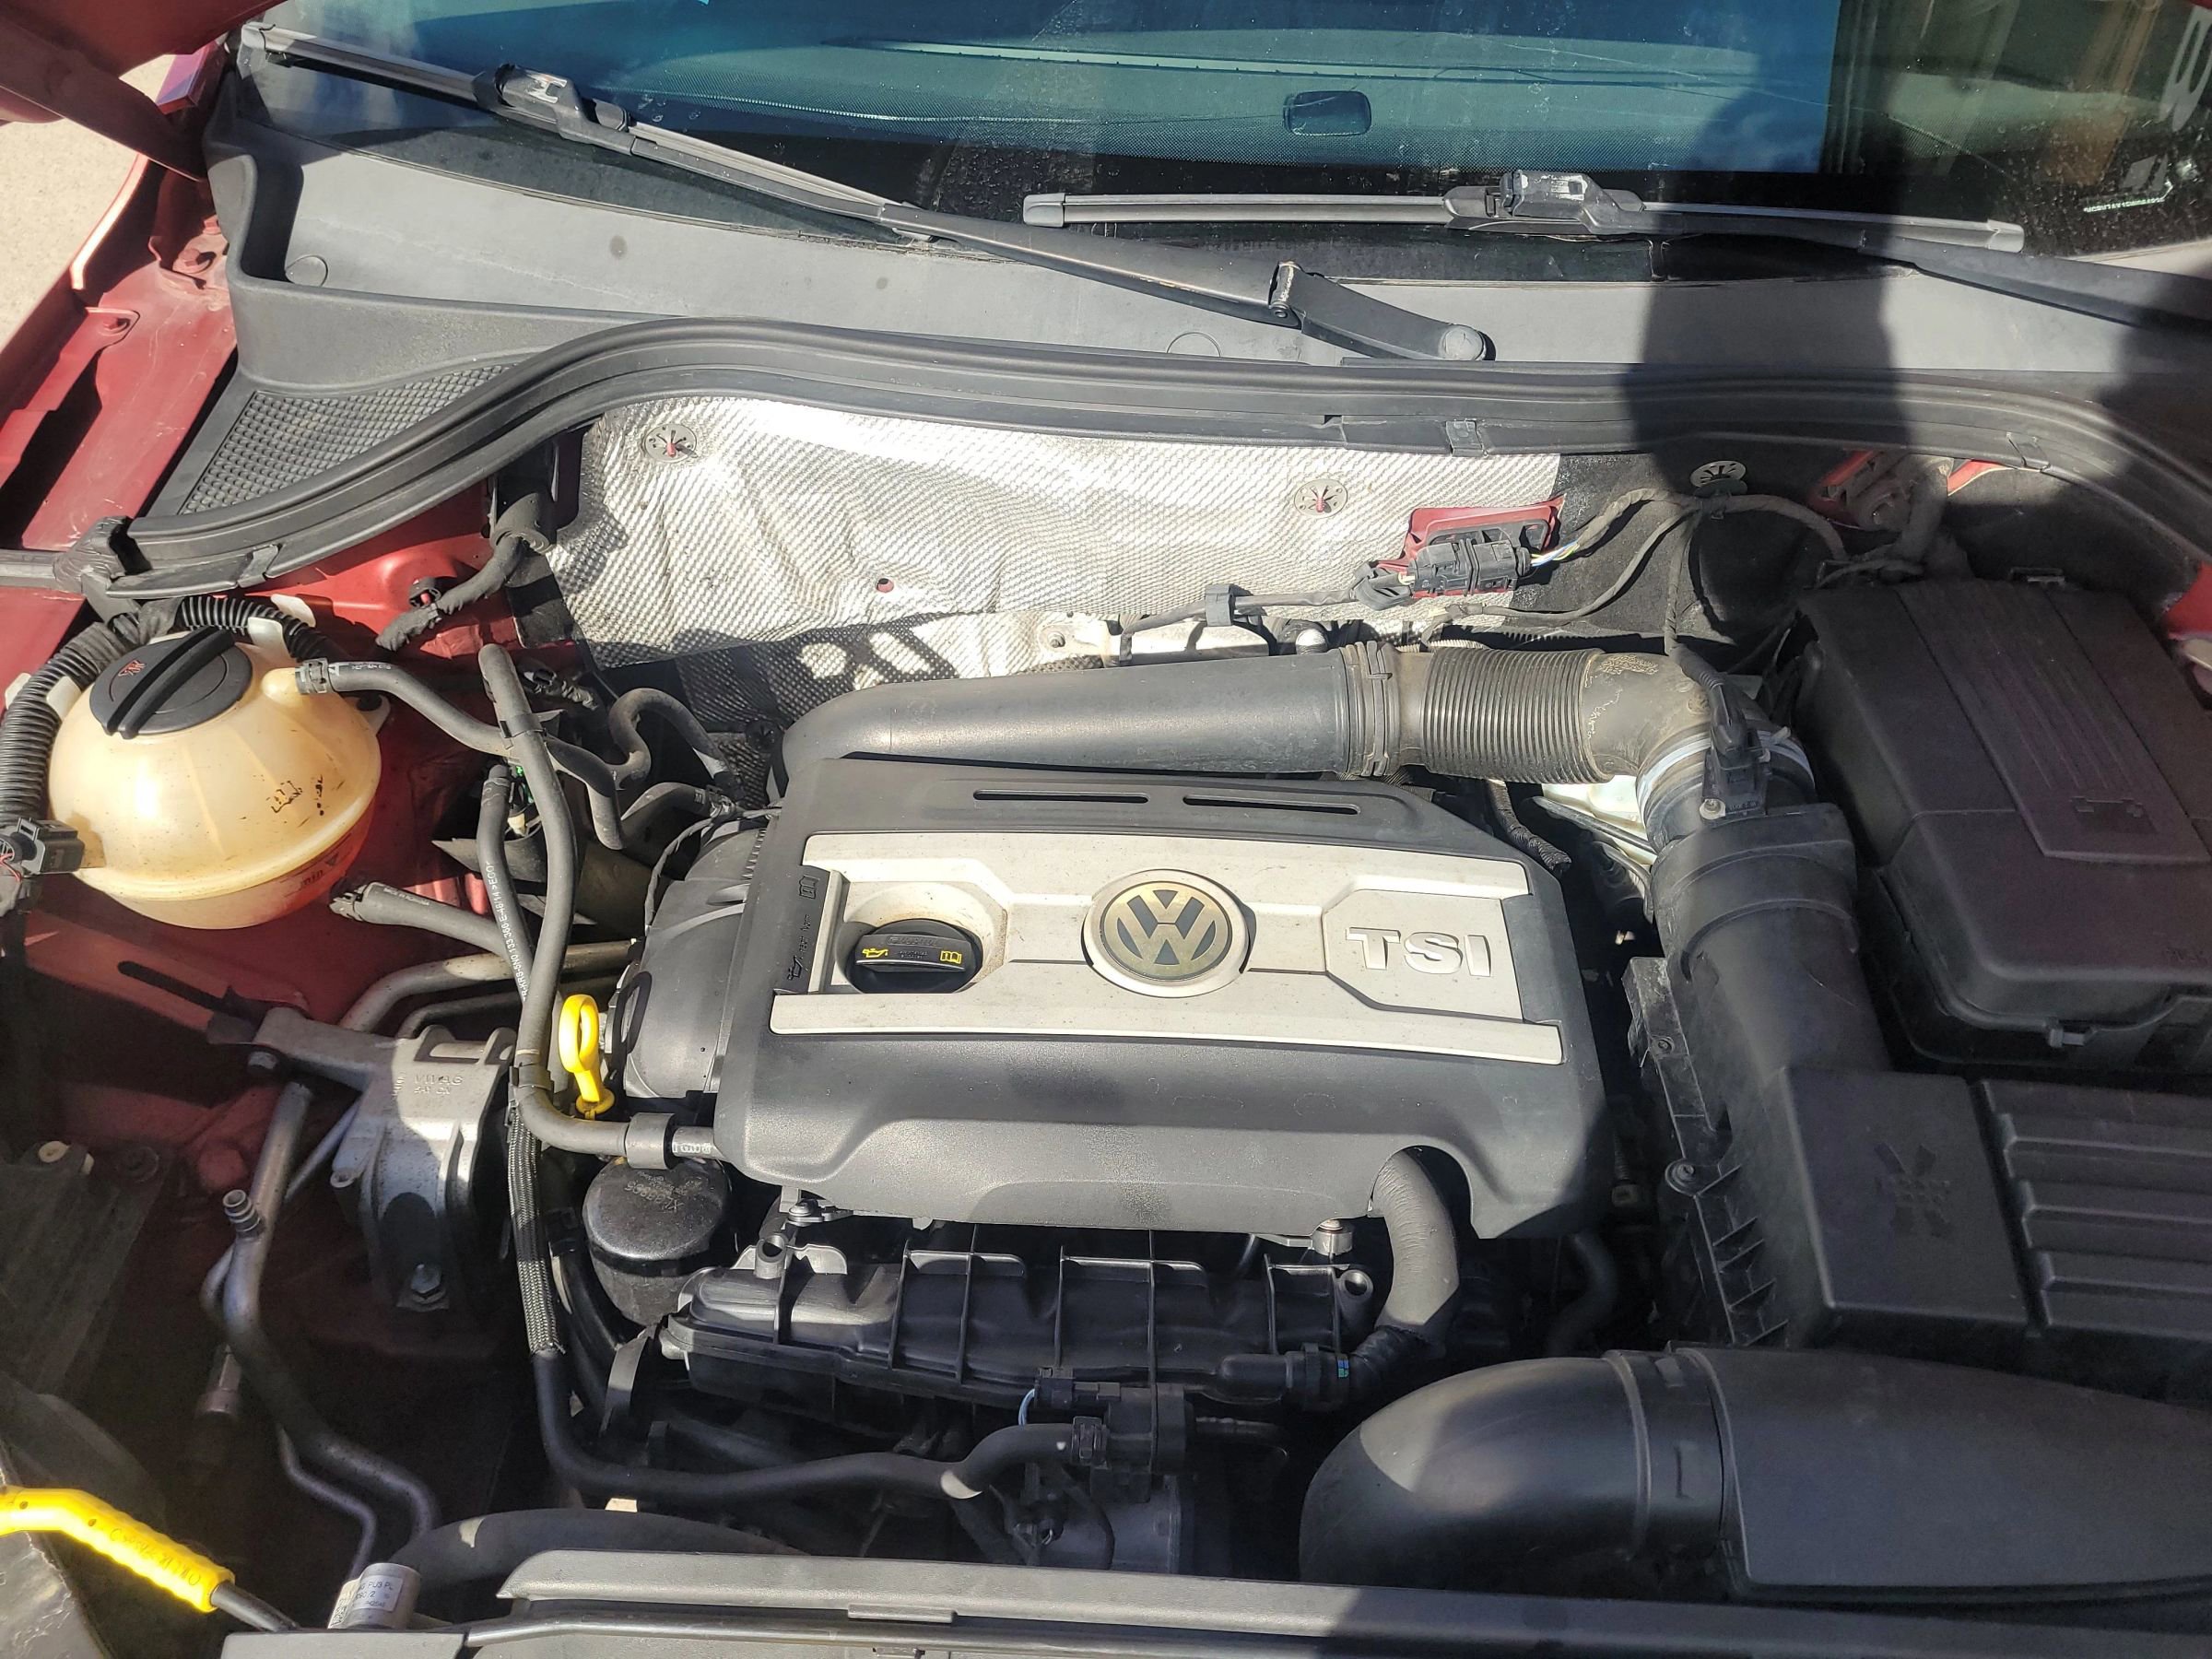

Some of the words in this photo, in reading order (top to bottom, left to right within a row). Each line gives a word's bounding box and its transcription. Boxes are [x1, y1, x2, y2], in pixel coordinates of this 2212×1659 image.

[505, 939, 516, 953] 133
[1100, 880, 1233, 982] VW
[1346, 926, 1492, 977] TSI
